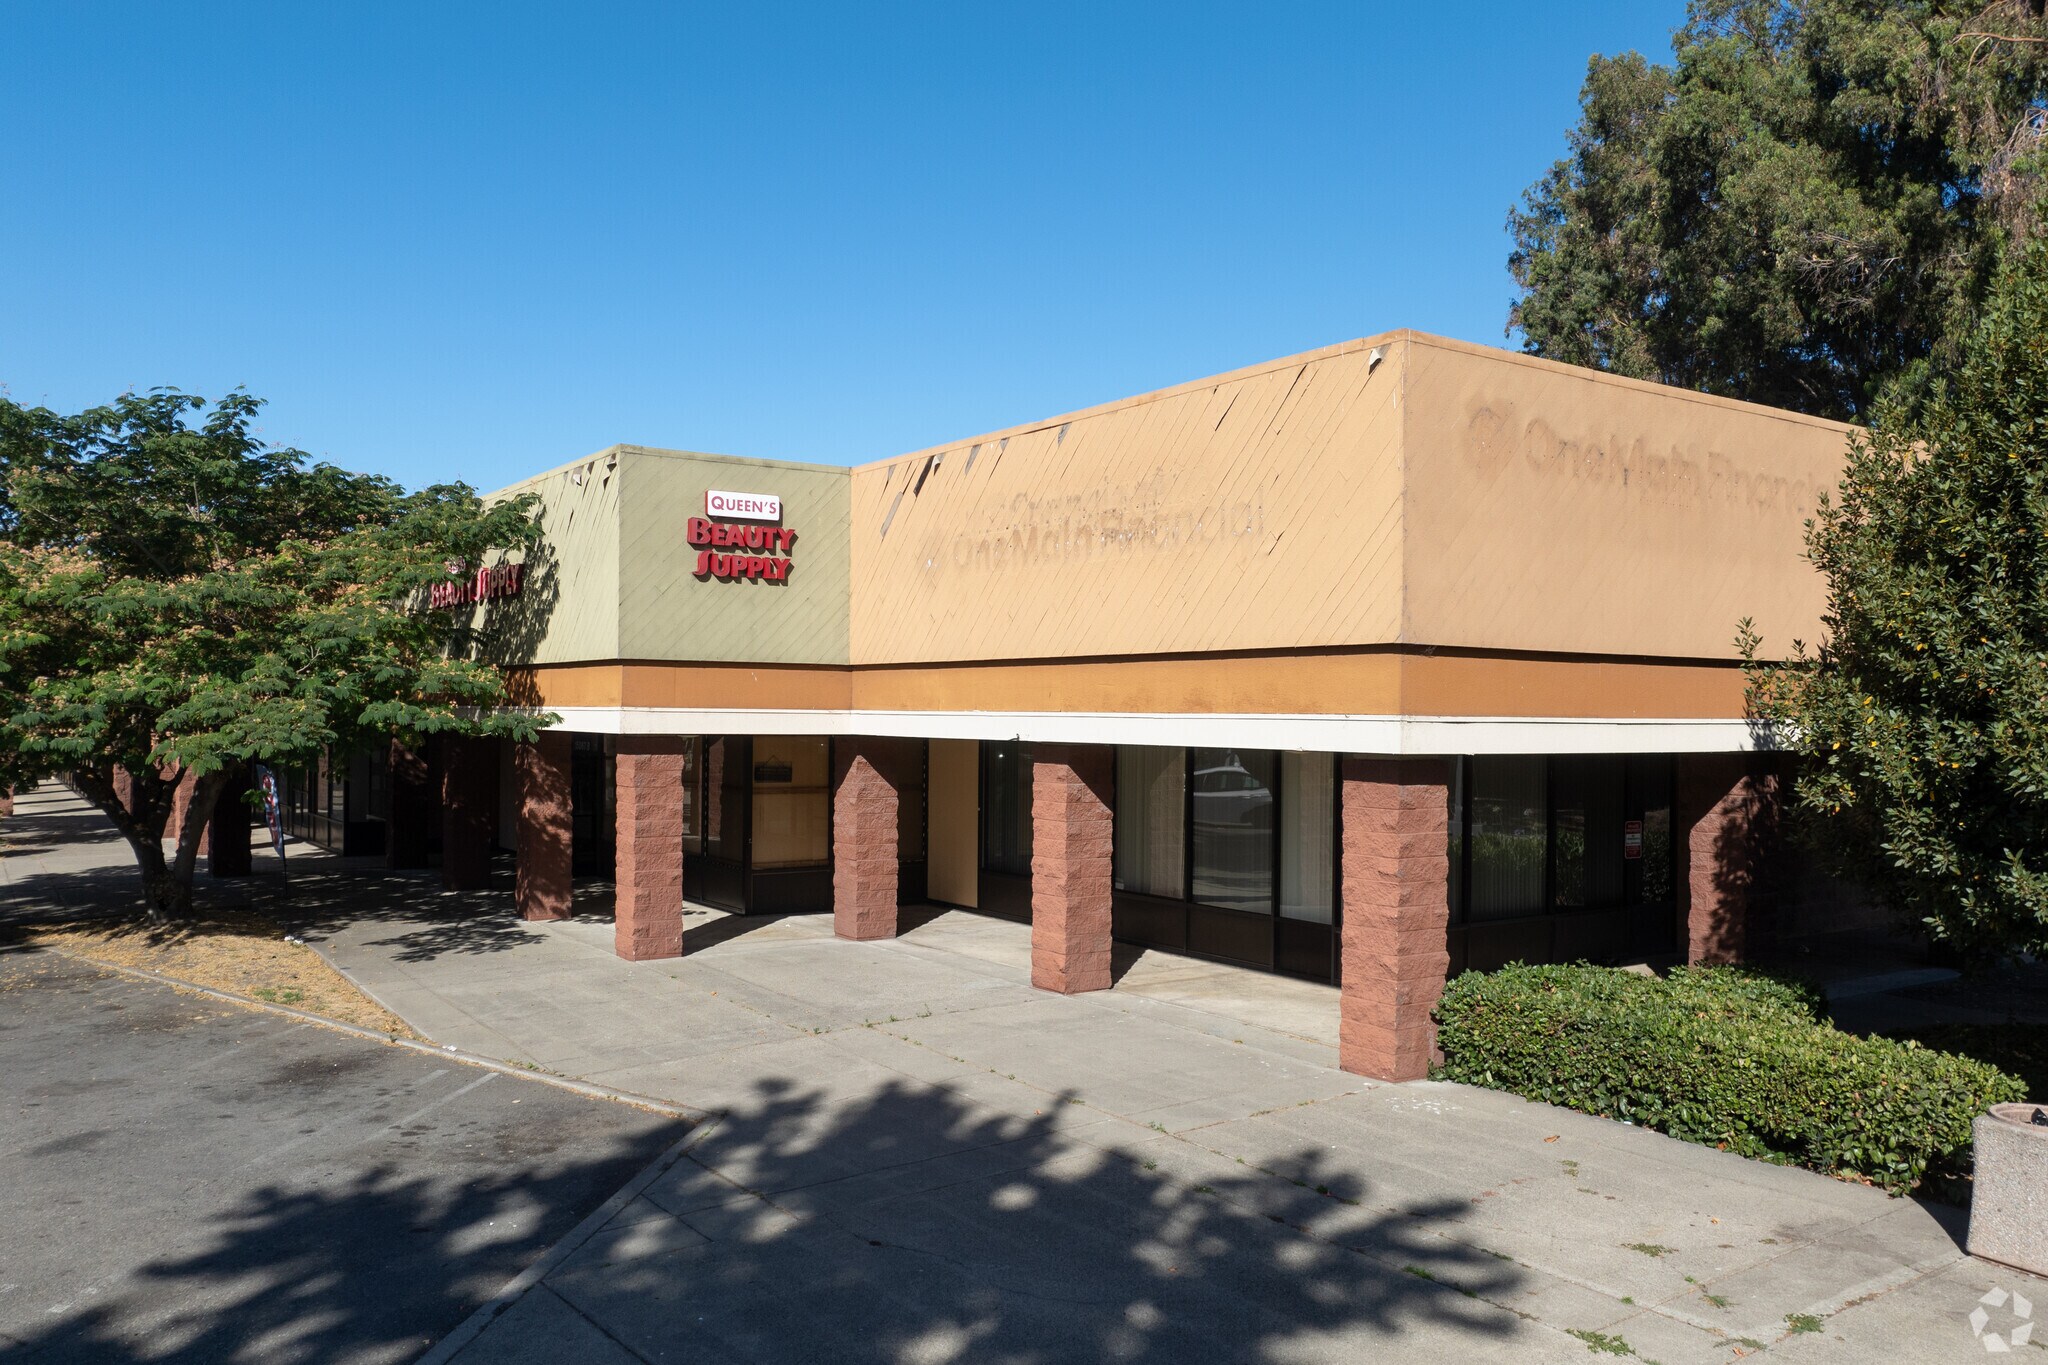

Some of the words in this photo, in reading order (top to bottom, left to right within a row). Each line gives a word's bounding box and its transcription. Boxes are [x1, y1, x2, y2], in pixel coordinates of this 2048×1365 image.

[711, 495, 777, 514] QUEEN'S
[687, 516, 796, 550] BEAUTY
[692, 548, 792, 580] SUPPLY
[473, 563, 524, 602] SUPPLY
